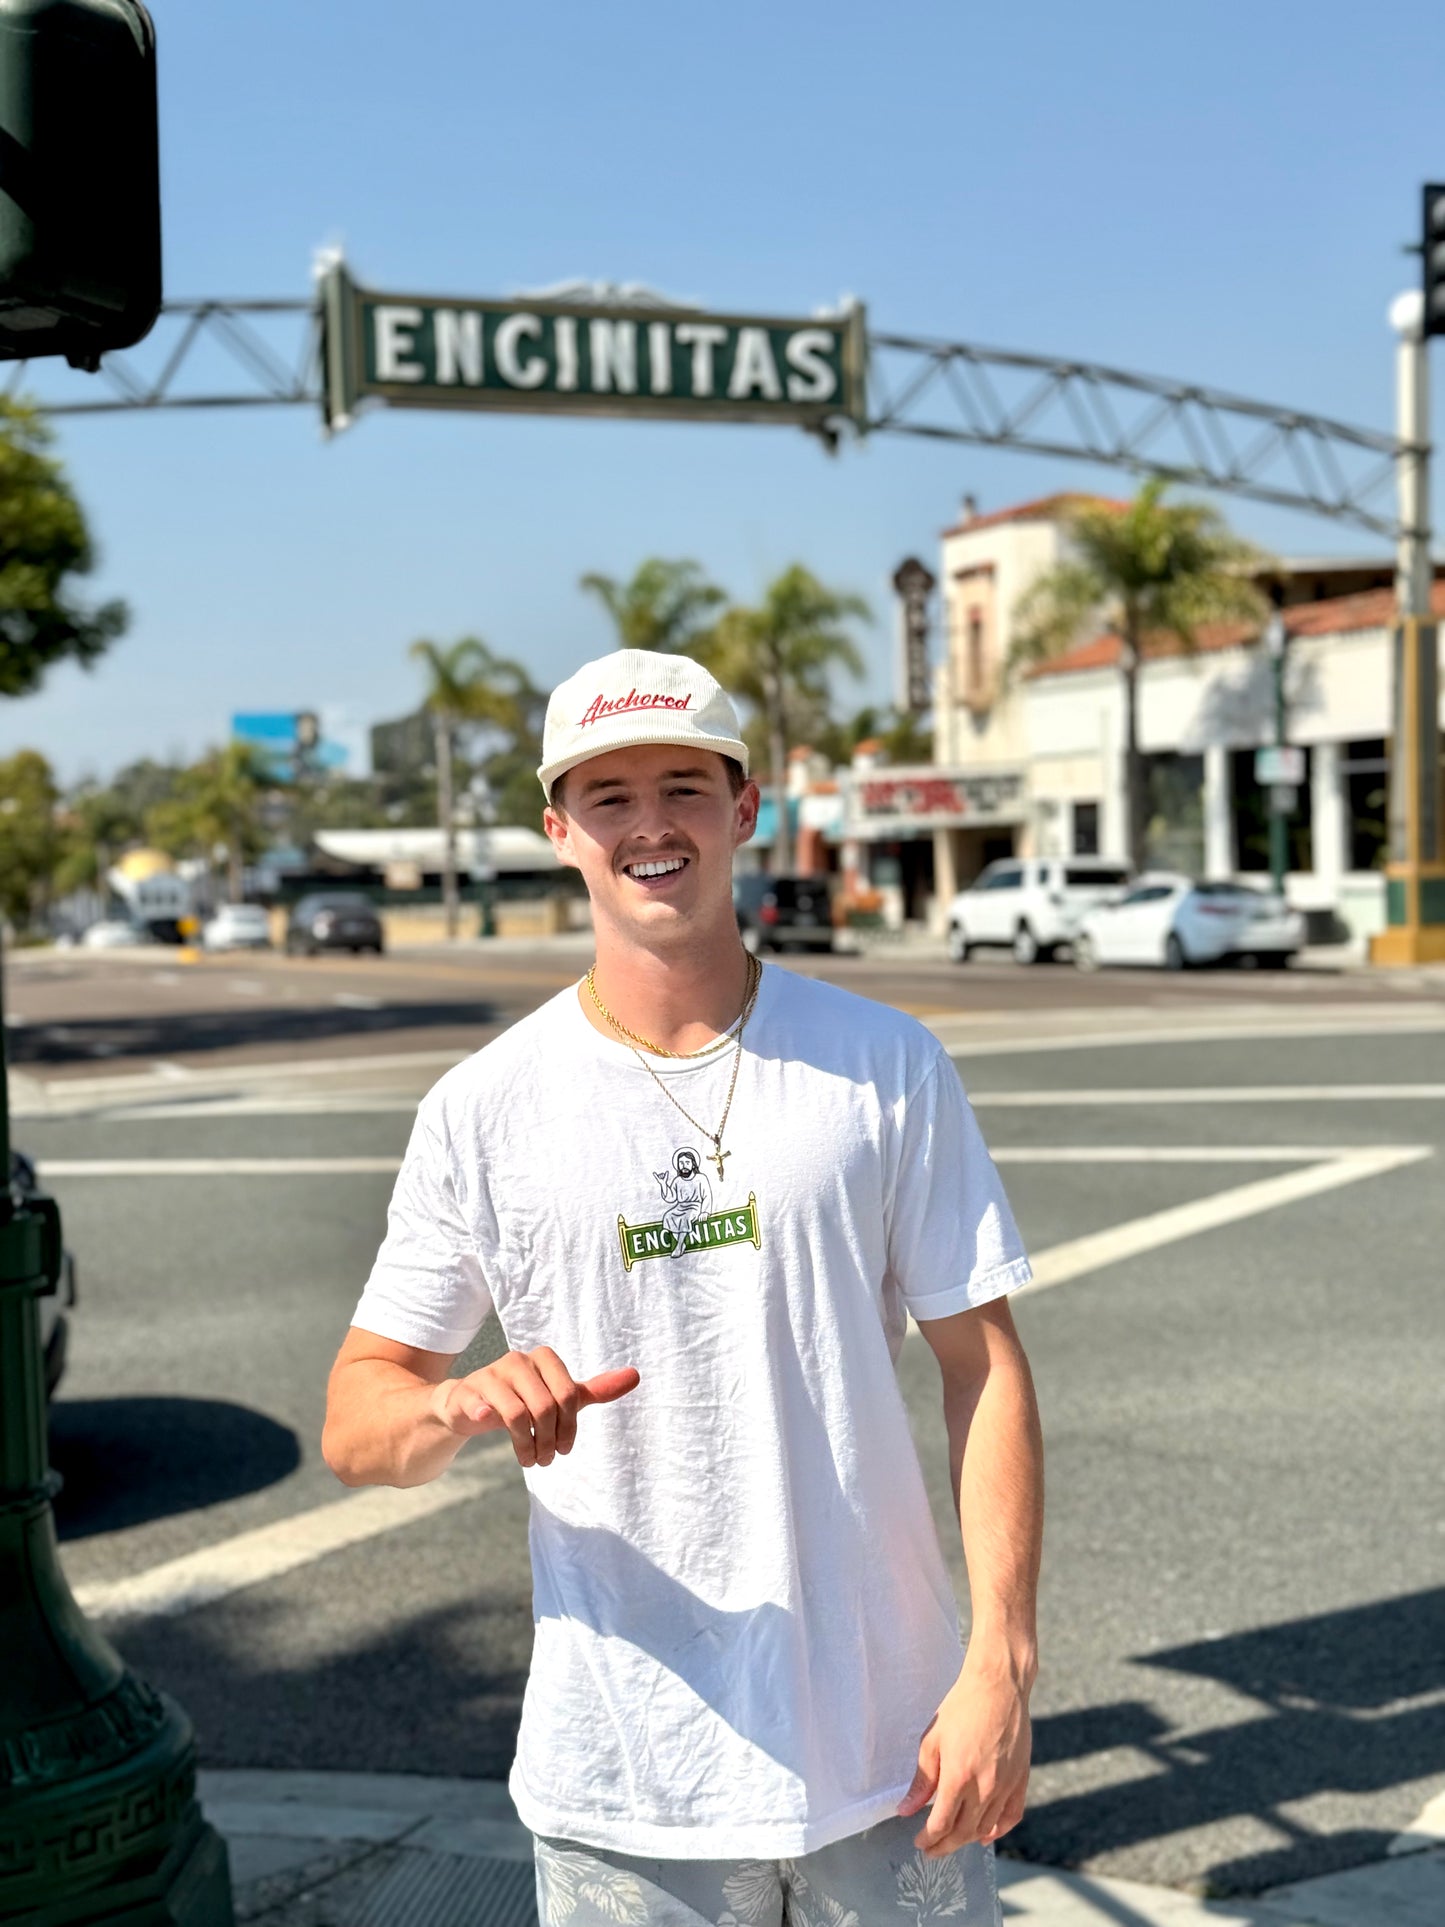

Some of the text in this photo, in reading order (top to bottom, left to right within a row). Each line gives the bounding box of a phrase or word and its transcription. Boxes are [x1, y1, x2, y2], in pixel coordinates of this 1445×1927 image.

[373, 305, 838, 401] ENCINITAS
[577, 688, 697, 729] Anchored
[632, 1215, 747, 1253] ENCNITAS
